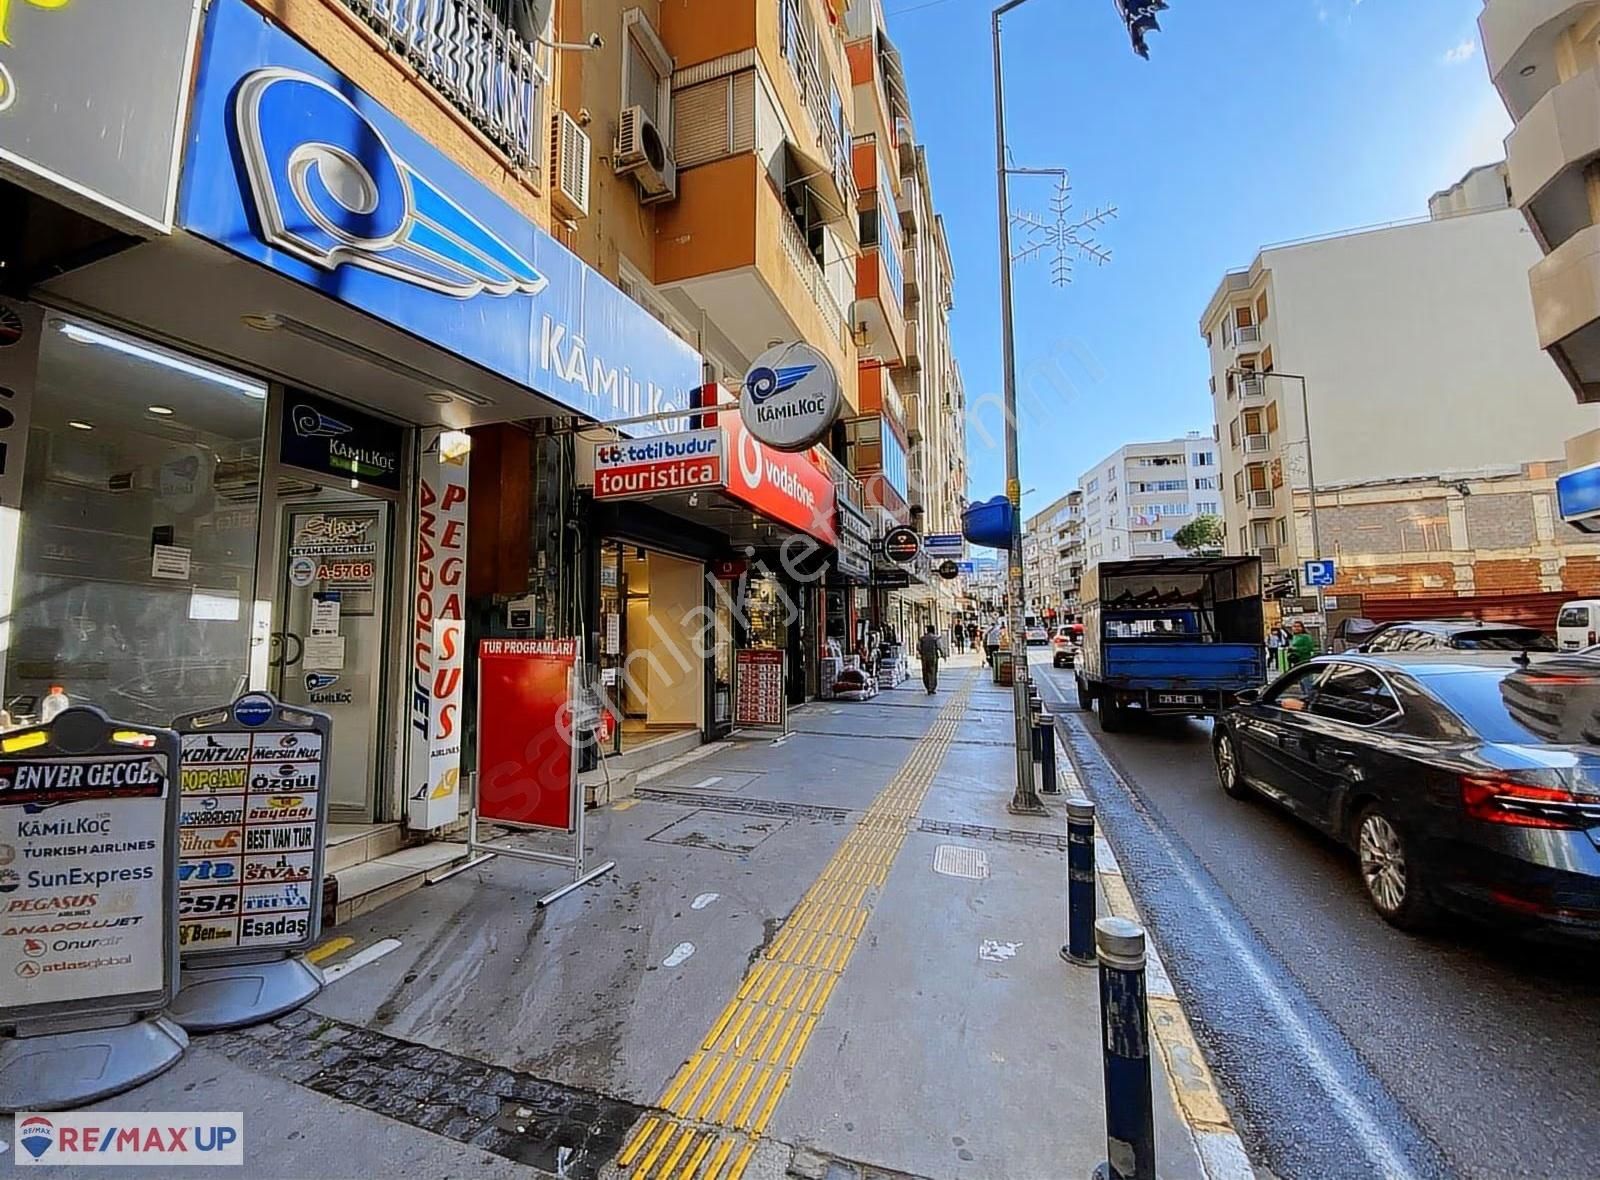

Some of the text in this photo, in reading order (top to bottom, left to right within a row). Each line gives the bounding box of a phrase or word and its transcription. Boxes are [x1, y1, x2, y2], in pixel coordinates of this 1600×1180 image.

[601, 461, 713, 493] touristica
[765, 458, 815, 511] vodafone
[1307, 562, 1325, 584] P
[483, 641, 574, 655] TUR PROGRAMLARI
[181, 747, 249, 762] KONTUR
[253, 747, 319, 760] Mersin Nur
[14, 765, 83, 790] ENVER
[252, 774, 315, 792] Özgül
[247, 827, 312, 851] BEST VAN TUR
[24, 840, 156, 858] TURKISH AIRLINES
[28, 866, 153, 888] SunExpress
[8, 894, 99, 912] PEGASUS
[1, 916, 144, 935] ANADOLUJET
[242, 916, 306, 937] Esadaş
[42, 955, 132, 973] atlasglobal
